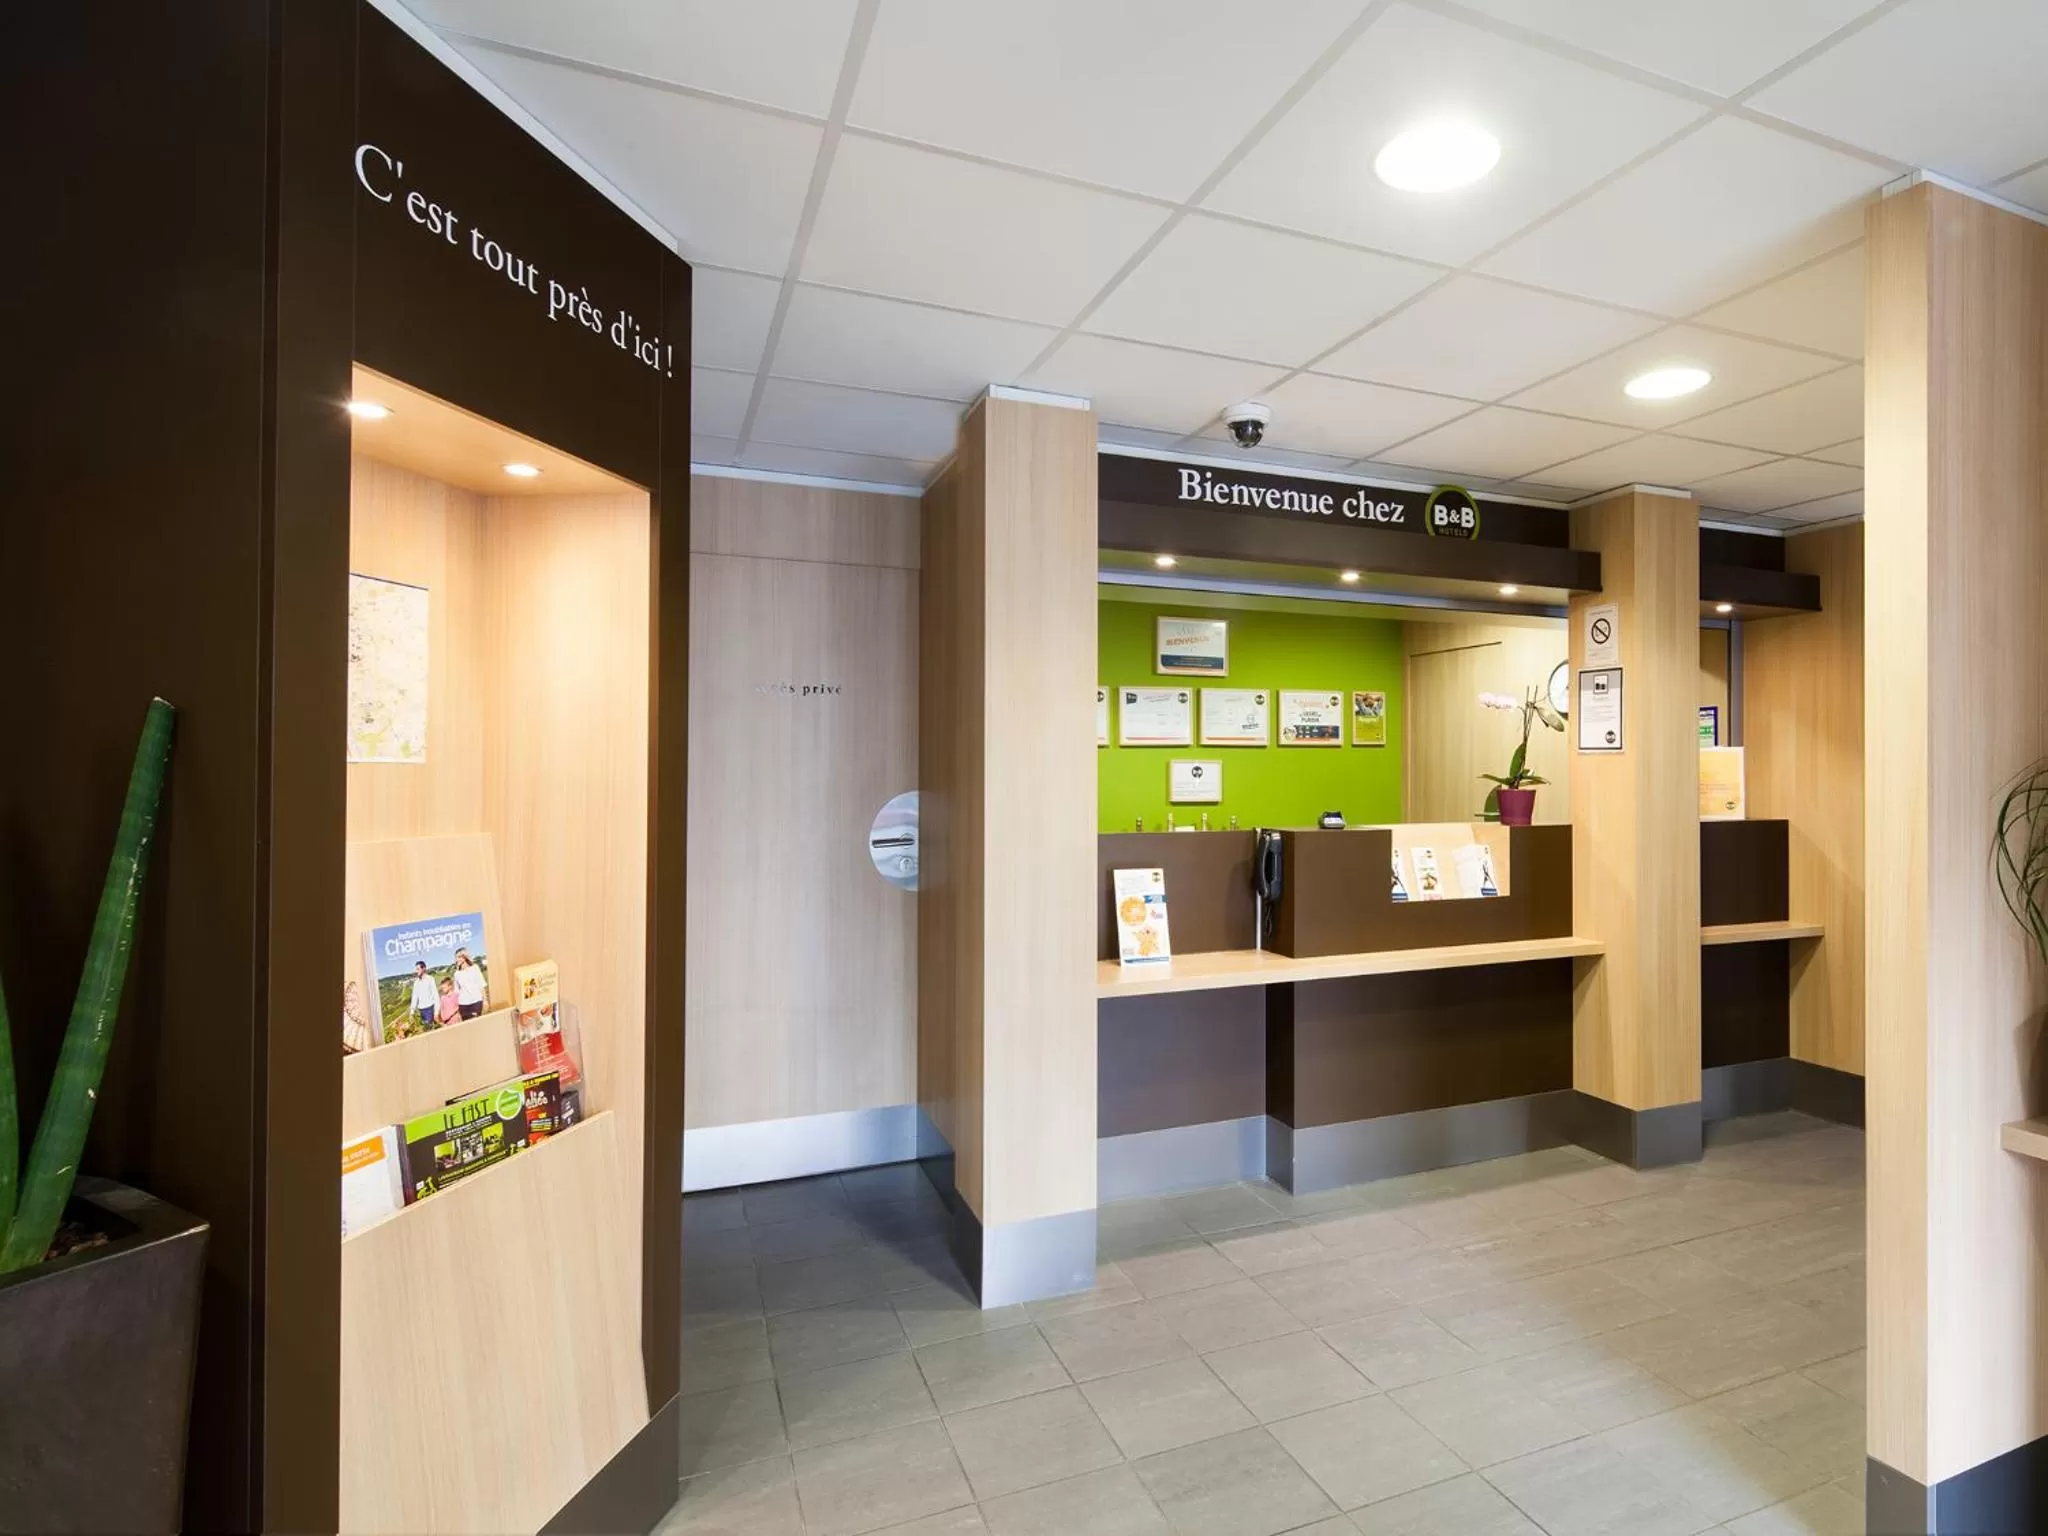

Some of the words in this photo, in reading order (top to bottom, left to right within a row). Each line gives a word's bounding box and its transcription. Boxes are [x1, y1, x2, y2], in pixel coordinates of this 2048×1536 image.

[354, 144, 458, 244] C'est
[470, 228, 538, 294] tout
[547, 280, 603, 334] près
[1178, 468, 1333, 515] Bienvenue
[1342, 490, 1405, 523] chez
[1434, 504, 1475, 528] B&B
[384, 928, 472, 957] Champagne
